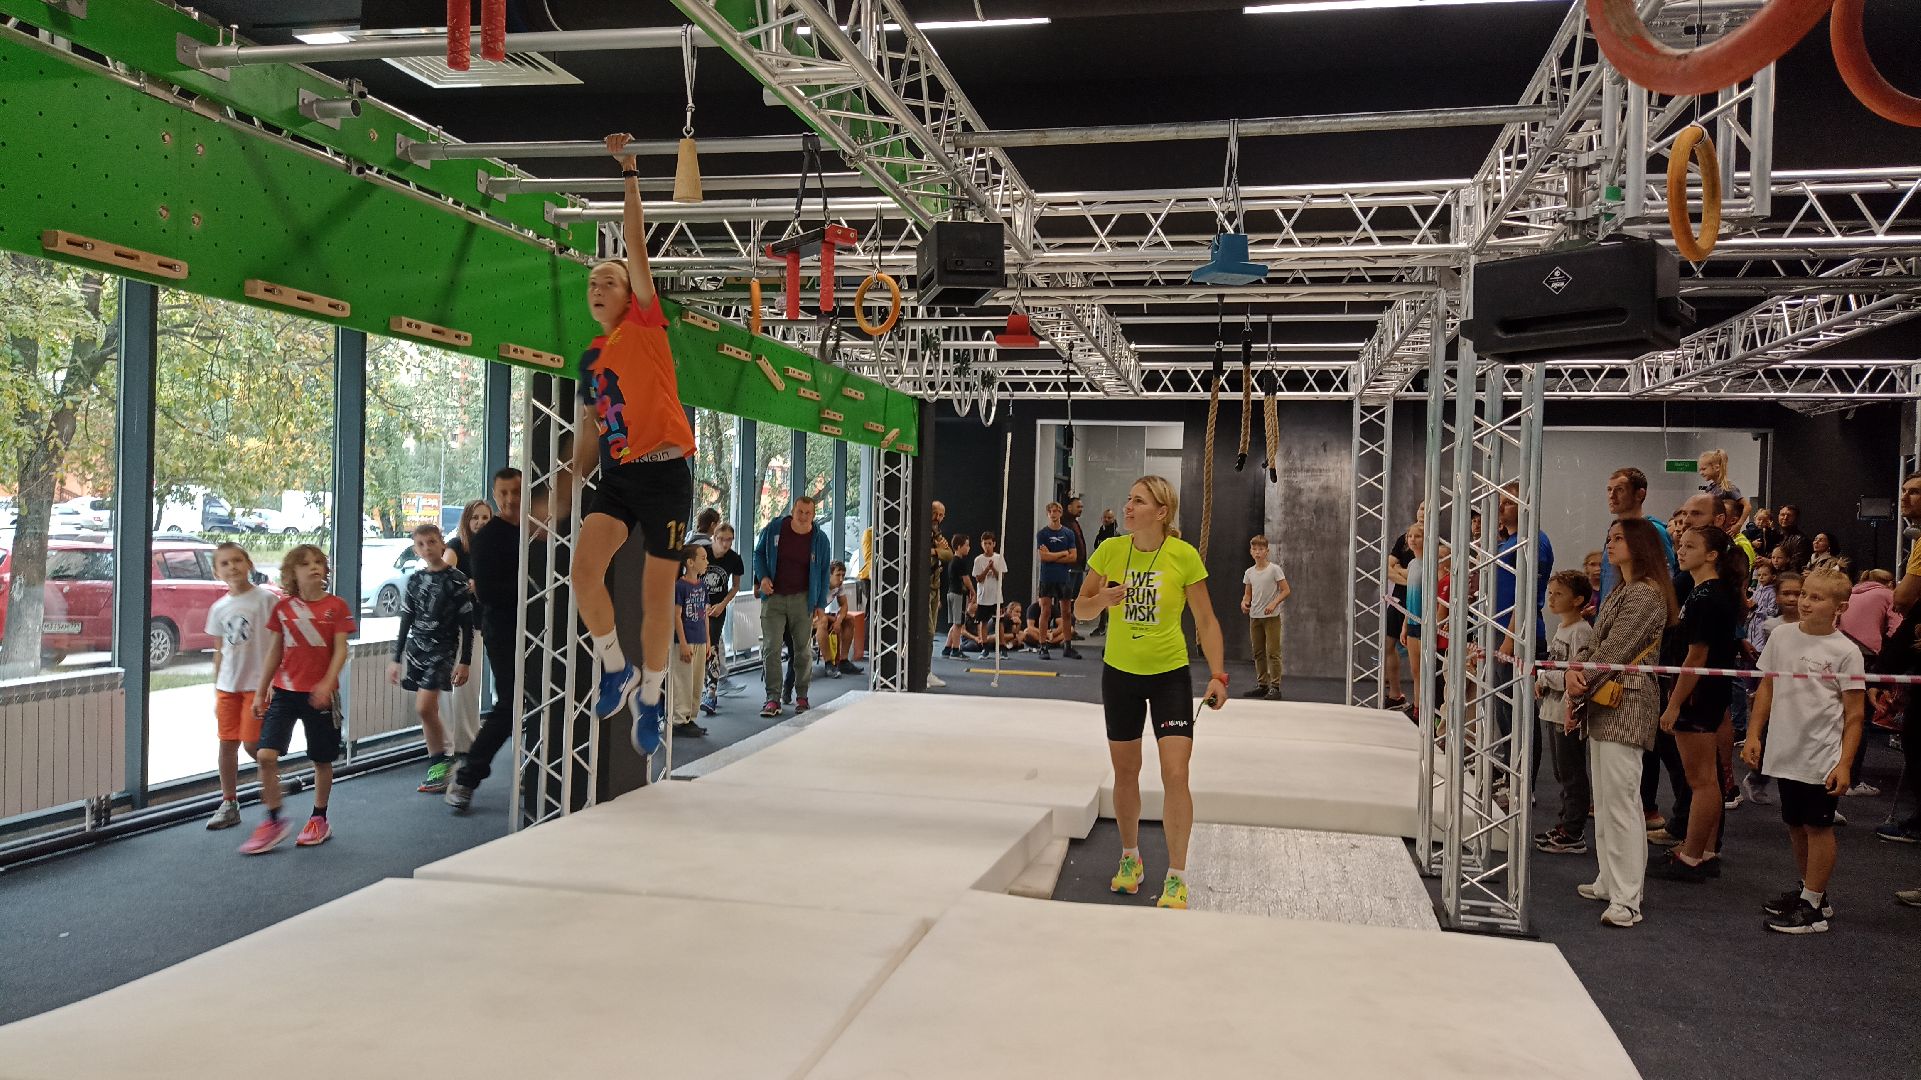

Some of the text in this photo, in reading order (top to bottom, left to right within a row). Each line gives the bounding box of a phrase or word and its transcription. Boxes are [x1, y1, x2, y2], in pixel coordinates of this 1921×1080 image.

[1131, 571, 1156, 588] WE
[1125, 587, 1157, 606] RUN
[1124, 603, 1157, 622] MSK
